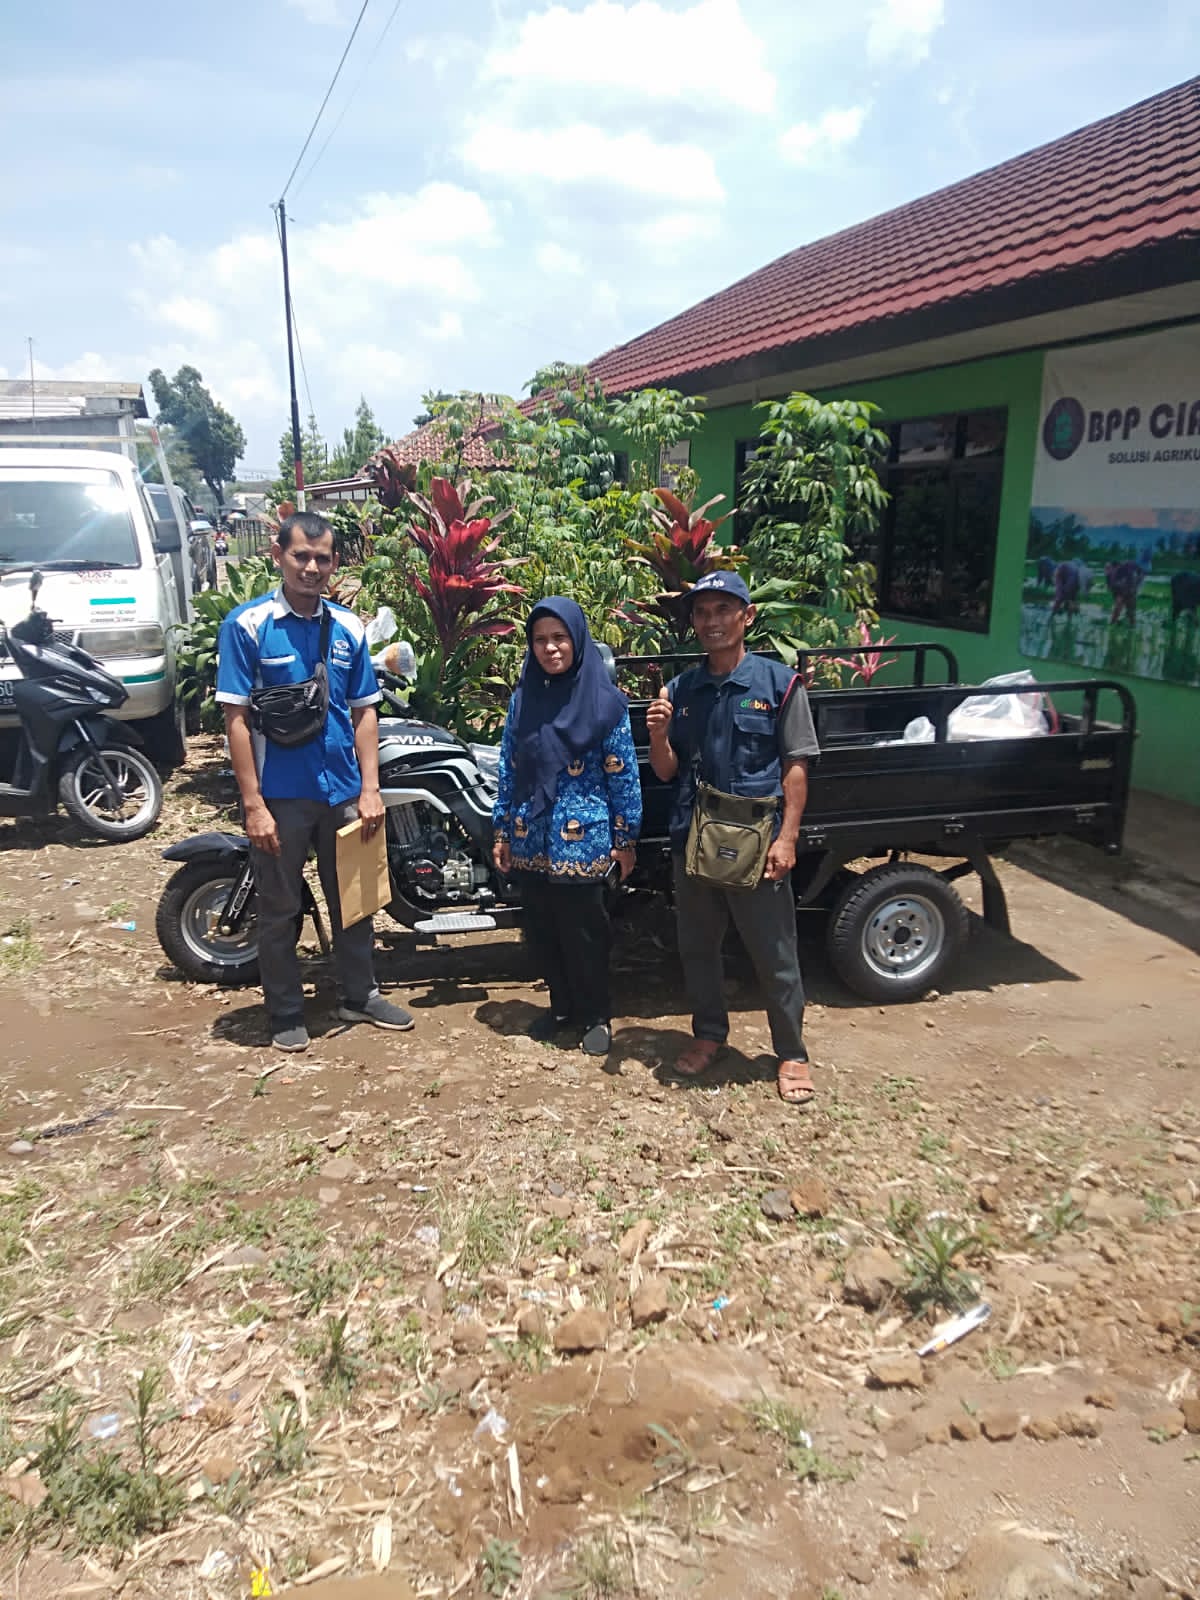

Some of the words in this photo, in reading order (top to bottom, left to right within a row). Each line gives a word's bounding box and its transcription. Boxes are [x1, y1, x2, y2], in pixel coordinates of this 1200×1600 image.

[1087, 406, 1141, 442] BPP
[1108, 451, 1151, 464] SOLUSI
[399, 735, 434, 745] VIAR
